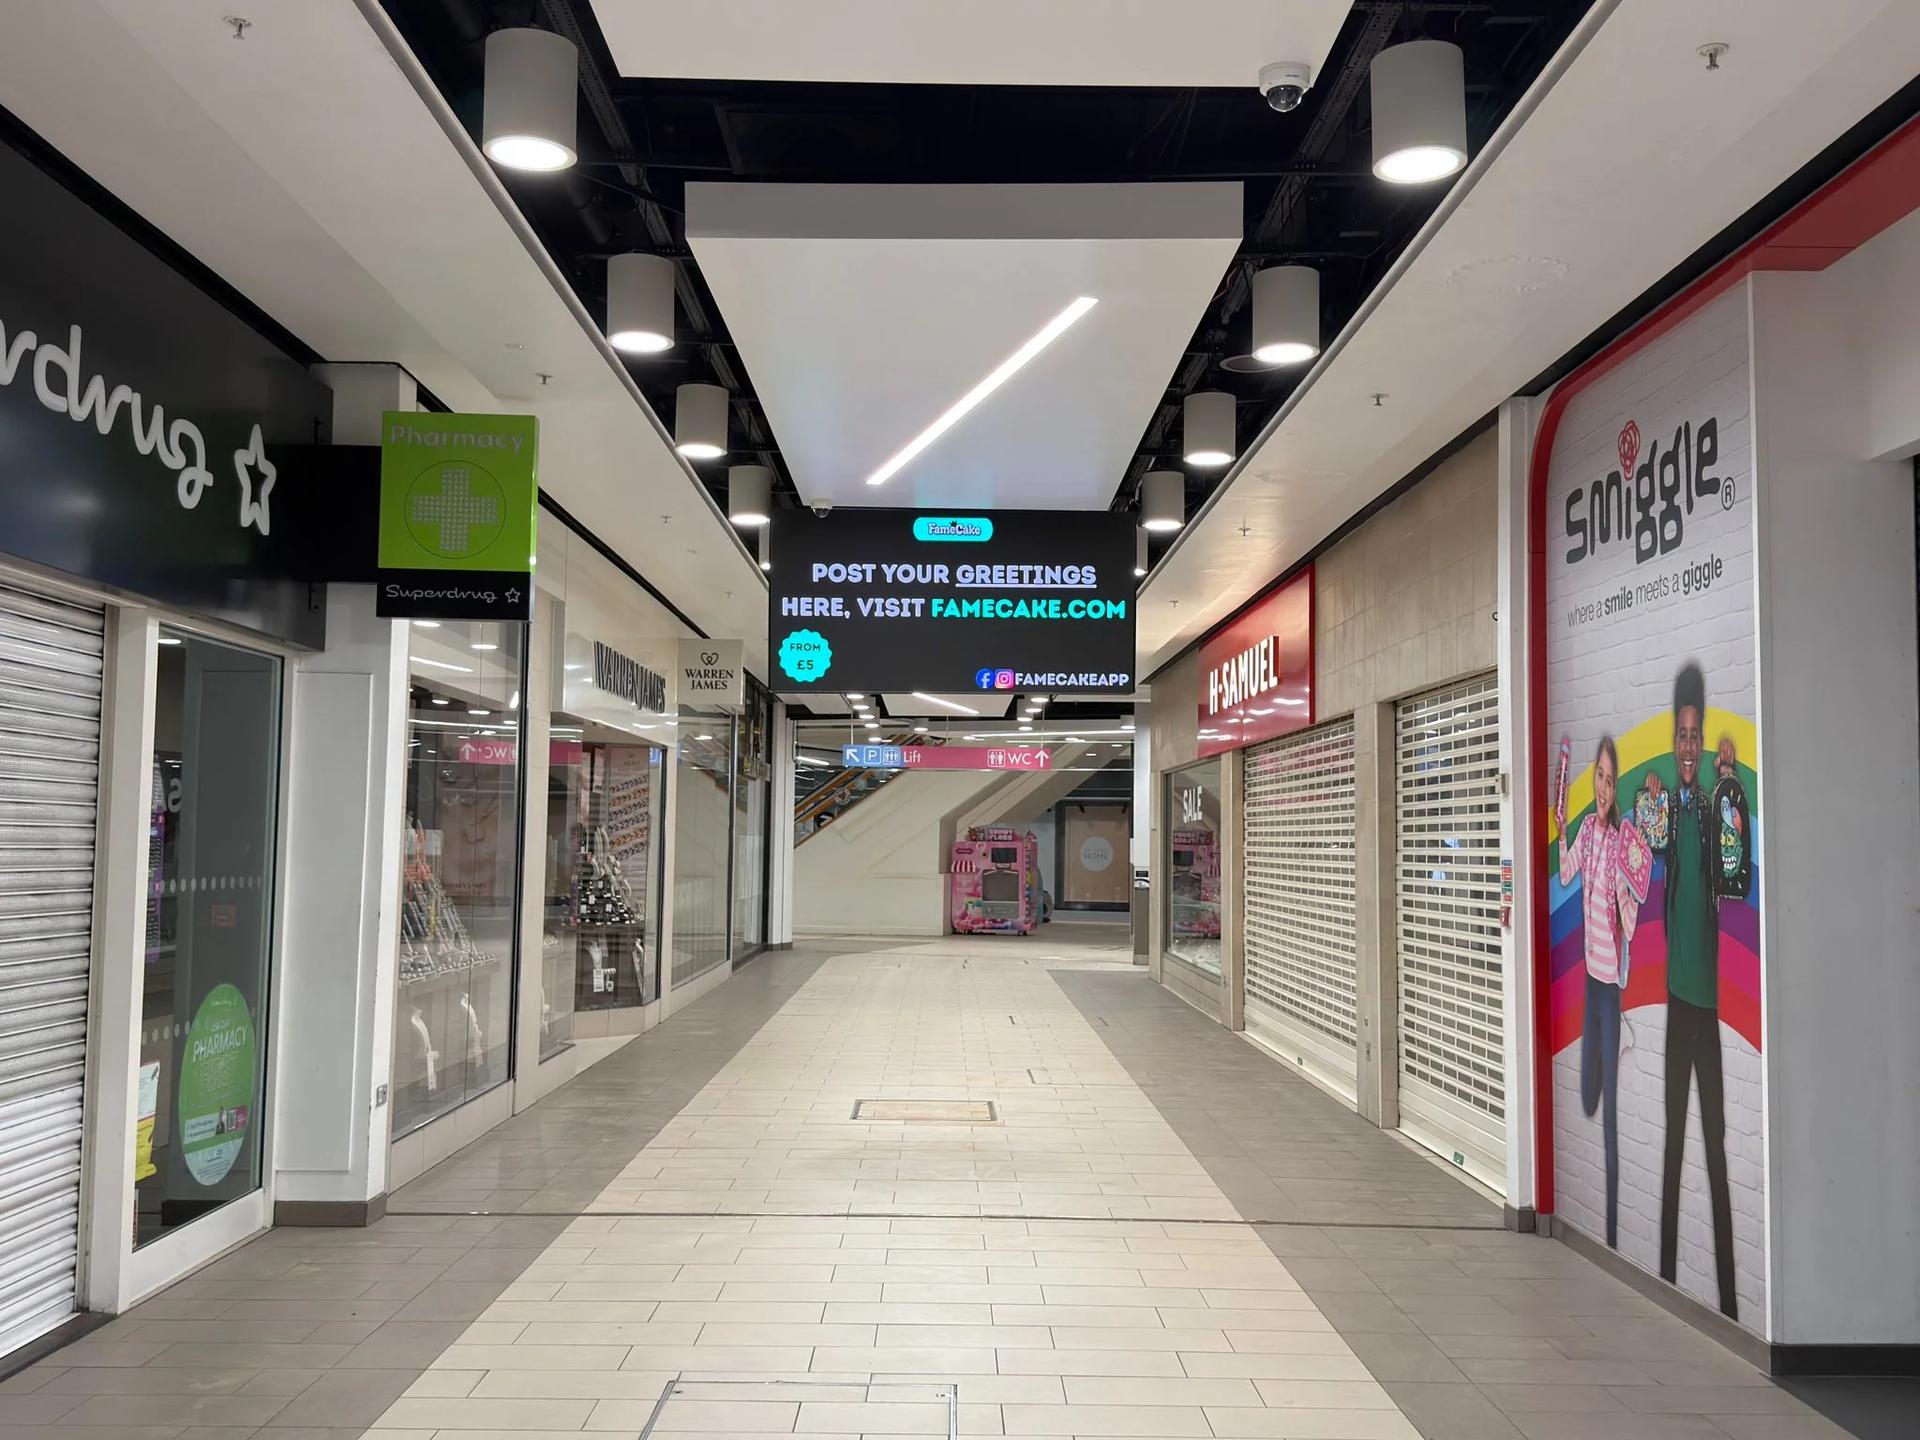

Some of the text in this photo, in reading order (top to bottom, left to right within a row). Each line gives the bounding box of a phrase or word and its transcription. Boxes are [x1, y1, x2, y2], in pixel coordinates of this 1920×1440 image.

[390, 425, 526, 455] Pharmacy
[927, 521, 981, 537] FameCake
[812, 563, 1097, 586] POST YOUR GREETINGS
[385, 584, 497, 603] Superdrug
[1567, 554, 1722, 628] where a smile meets a giggle
[781, 597, 1126, 619] HERE, VISIT FAMECAKE.COM
[789, 643, 821, 652] FROM
[685, 668, 734, 679] WARREN
[796, 659, 814, 671] £5
[593, 640, 666, 714] WARREN JAMES
[690, 679, 728, 690] JAMES
[1015, 672, 1130, 687] FAMECAKEAPP
[903, 750, 922, 764] Lift
[1007, 753, 1032, 766] WC
[1182, 785, 1203, 823] SALE
[192, 1024, 249, 1063] PHARMACY
